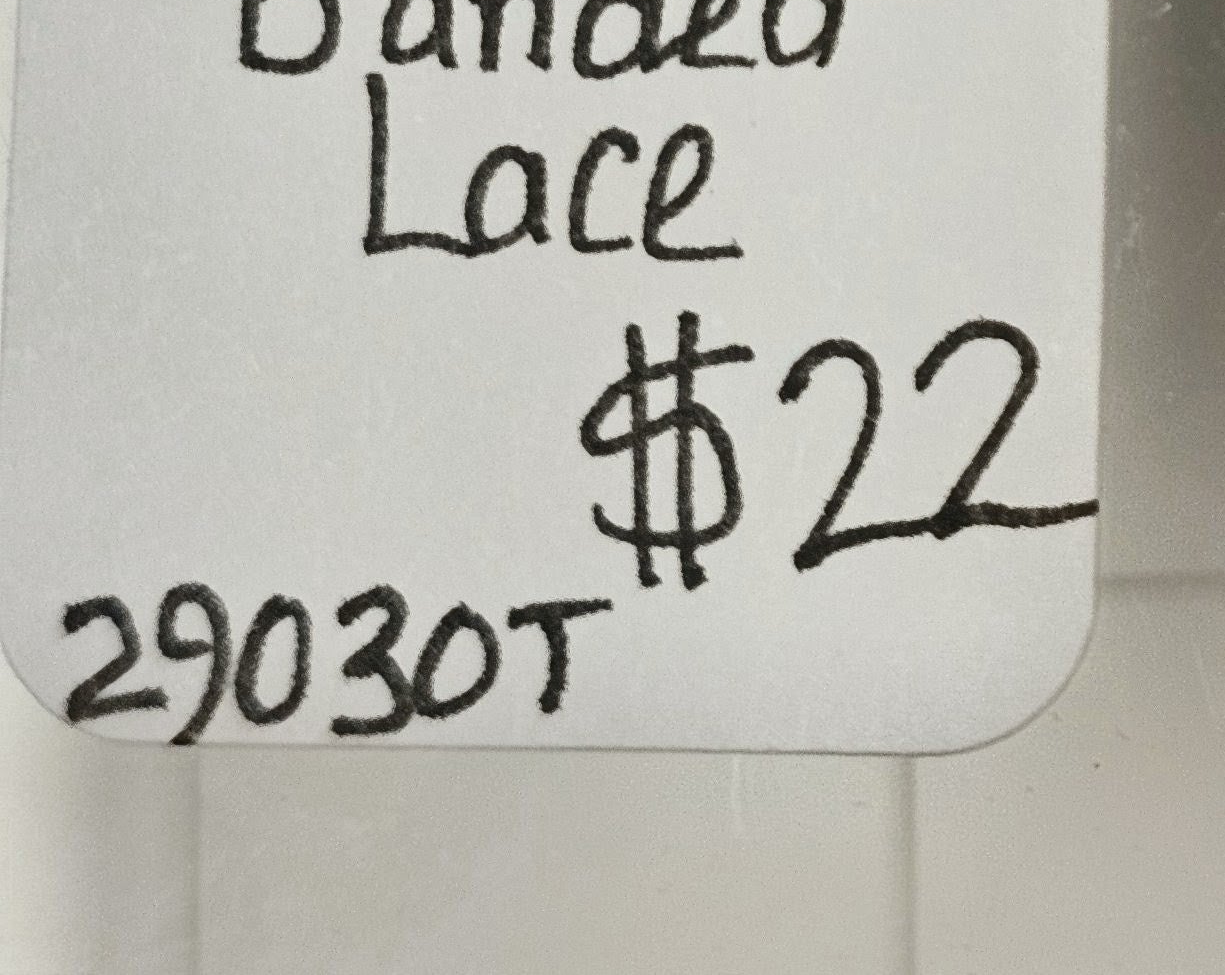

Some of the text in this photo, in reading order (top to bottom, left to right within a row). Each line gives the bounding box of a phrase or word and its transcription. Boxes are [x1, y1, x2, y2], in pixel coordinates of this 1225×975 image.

[362, 72, 744, 262] Lace
[578, 310, 1100, 591] $22
[62, 582, 613, 748] 29030T
